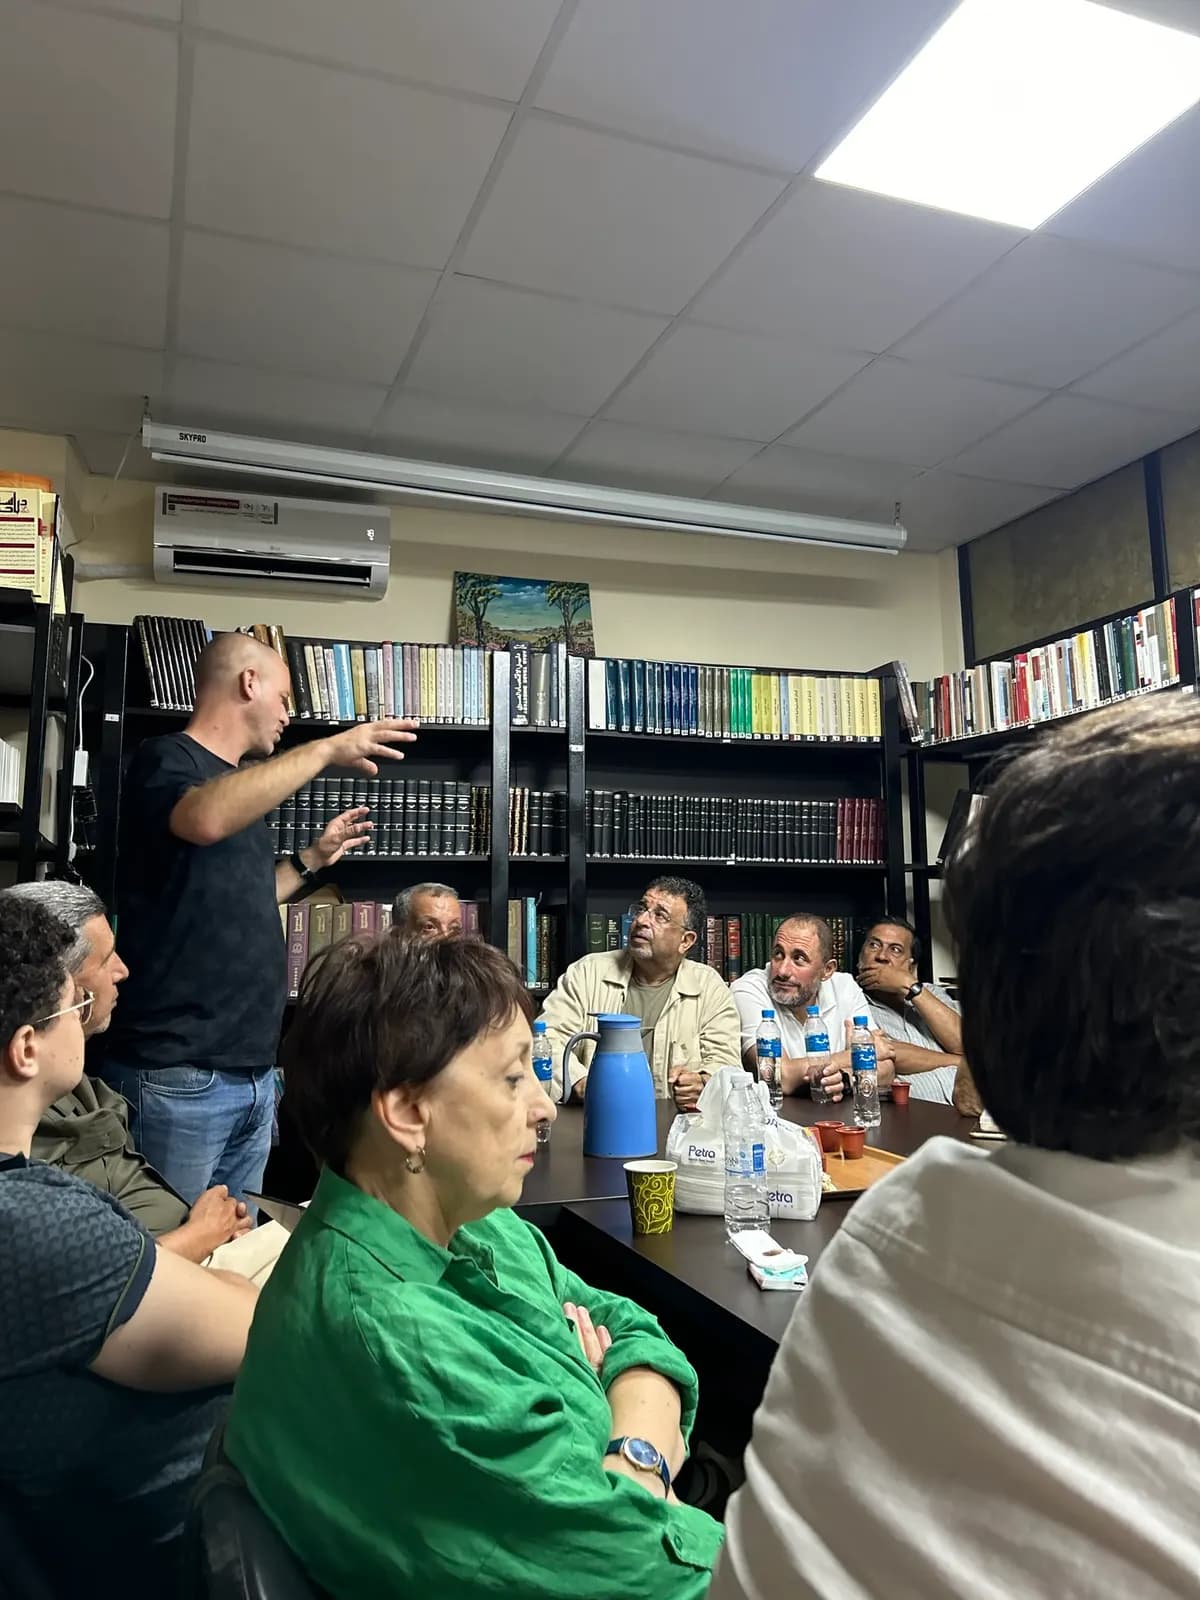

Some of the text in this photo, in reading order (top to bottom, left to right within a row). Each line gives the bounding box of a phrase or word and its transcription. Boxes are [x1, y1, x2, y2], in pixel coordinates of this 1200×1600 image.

[179, 432, 206, 443] SKYPRO
[688, 1145, 716, 1158] Petra
[768, 1190, 793, 1203] etra
